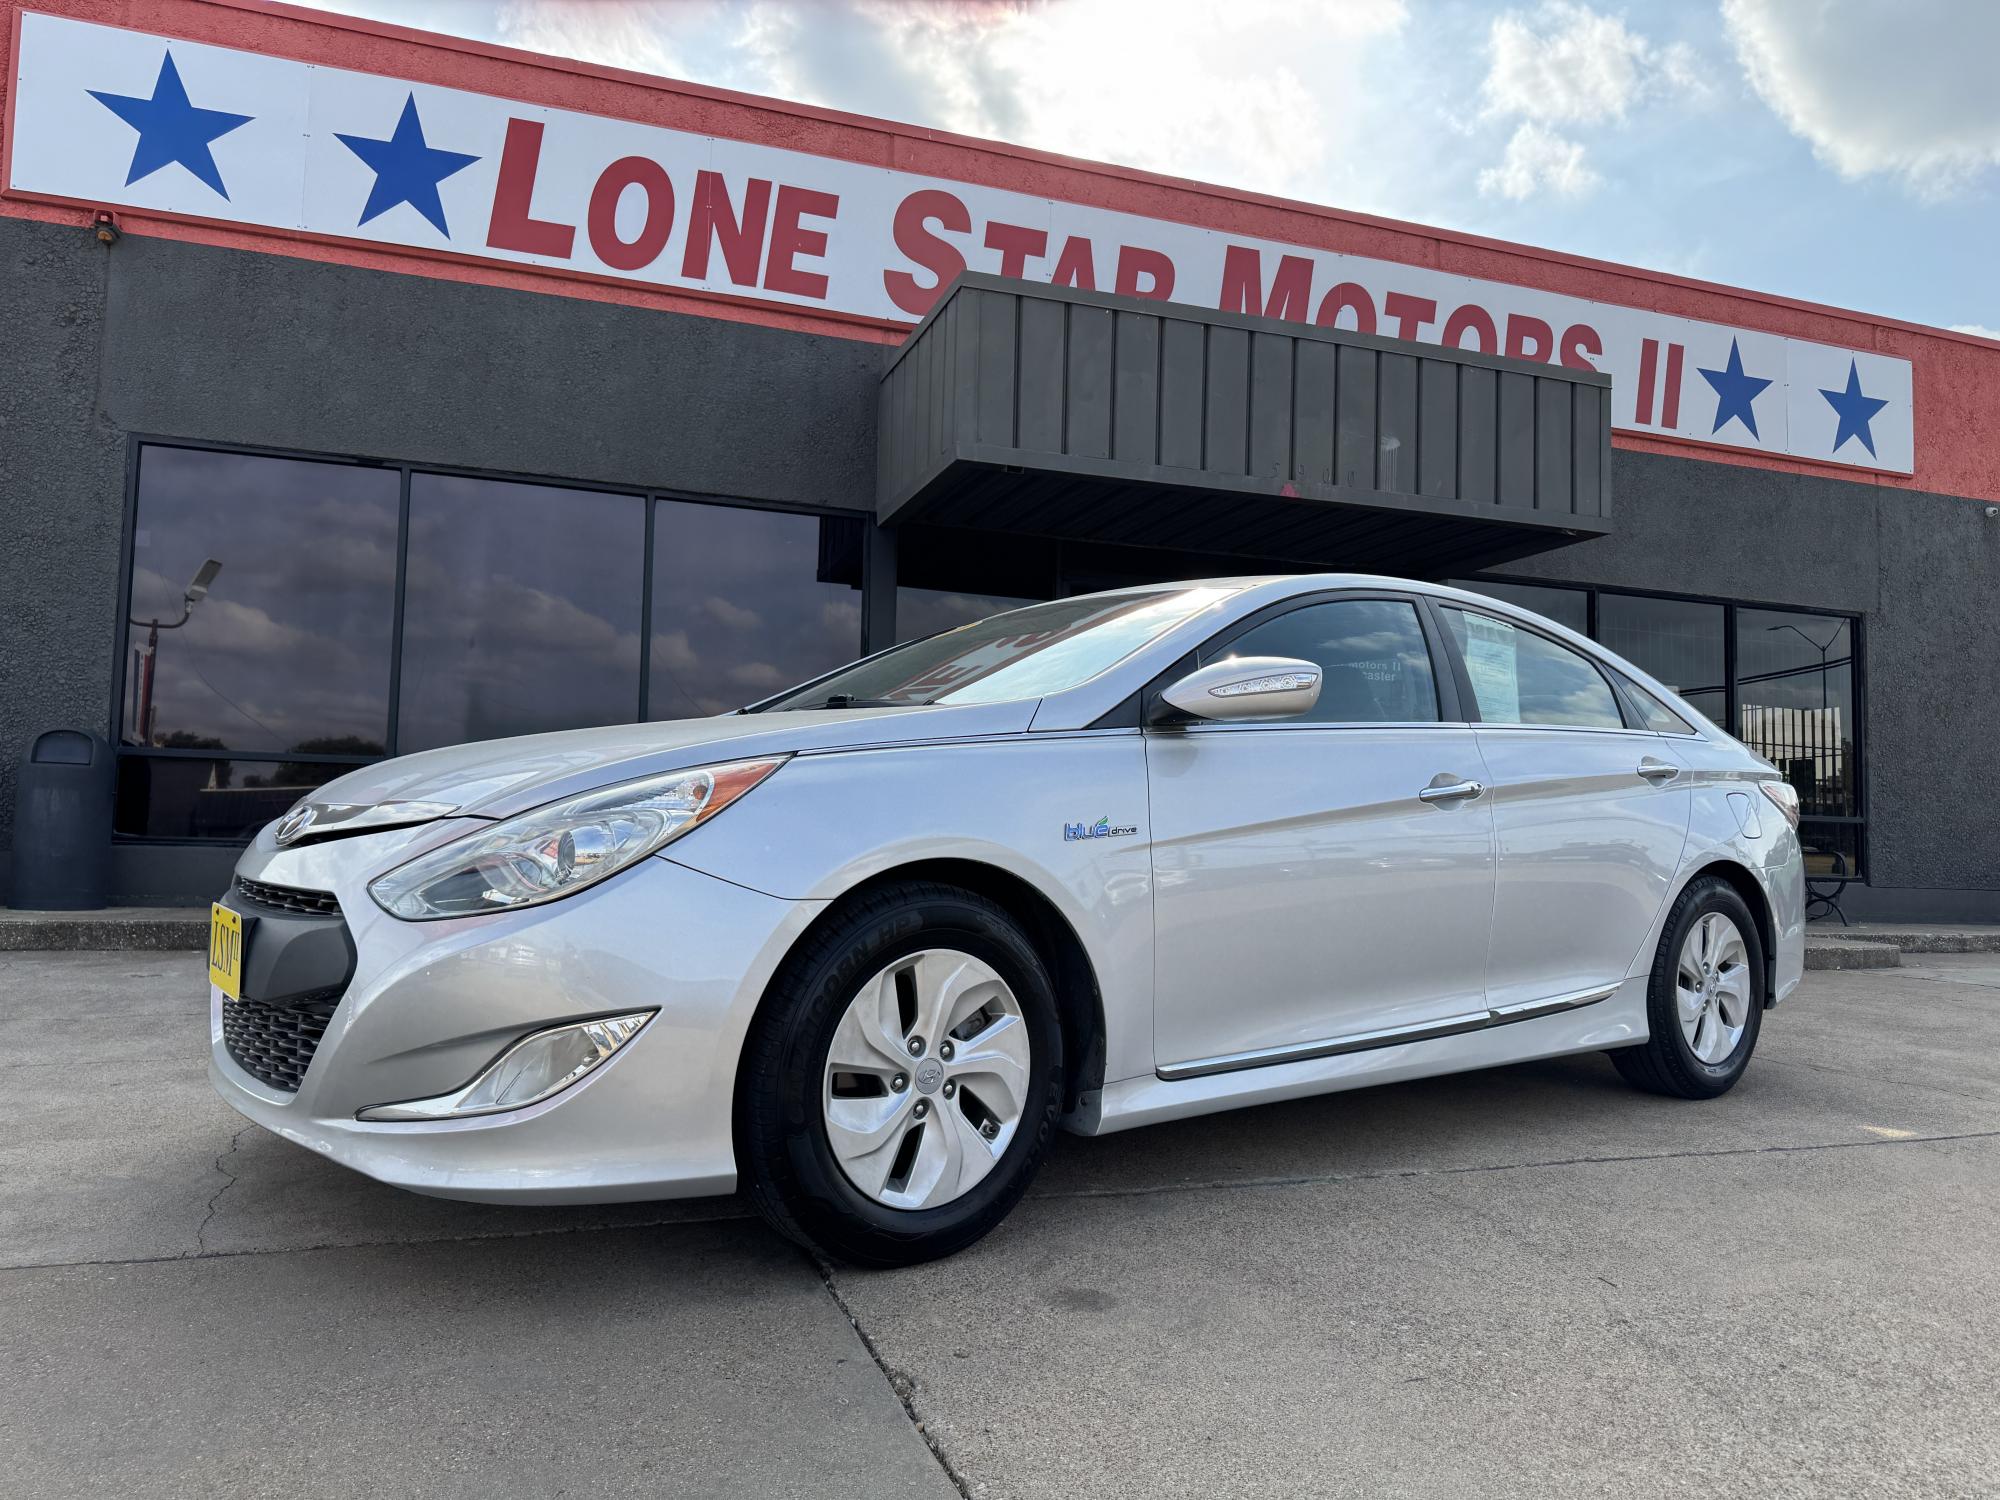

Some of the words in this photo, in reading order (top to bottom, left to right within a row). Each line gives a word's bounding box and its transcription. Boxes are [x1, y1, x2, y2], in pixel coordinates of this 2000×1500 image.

[486, 117, 839, 300] LONE
[883, 189, 1175, 316] STAR
[1635, 338, 1684, 429] II
[1063, 820, 1108, 841] blue
[1111, 826, 1137, 836] drive
